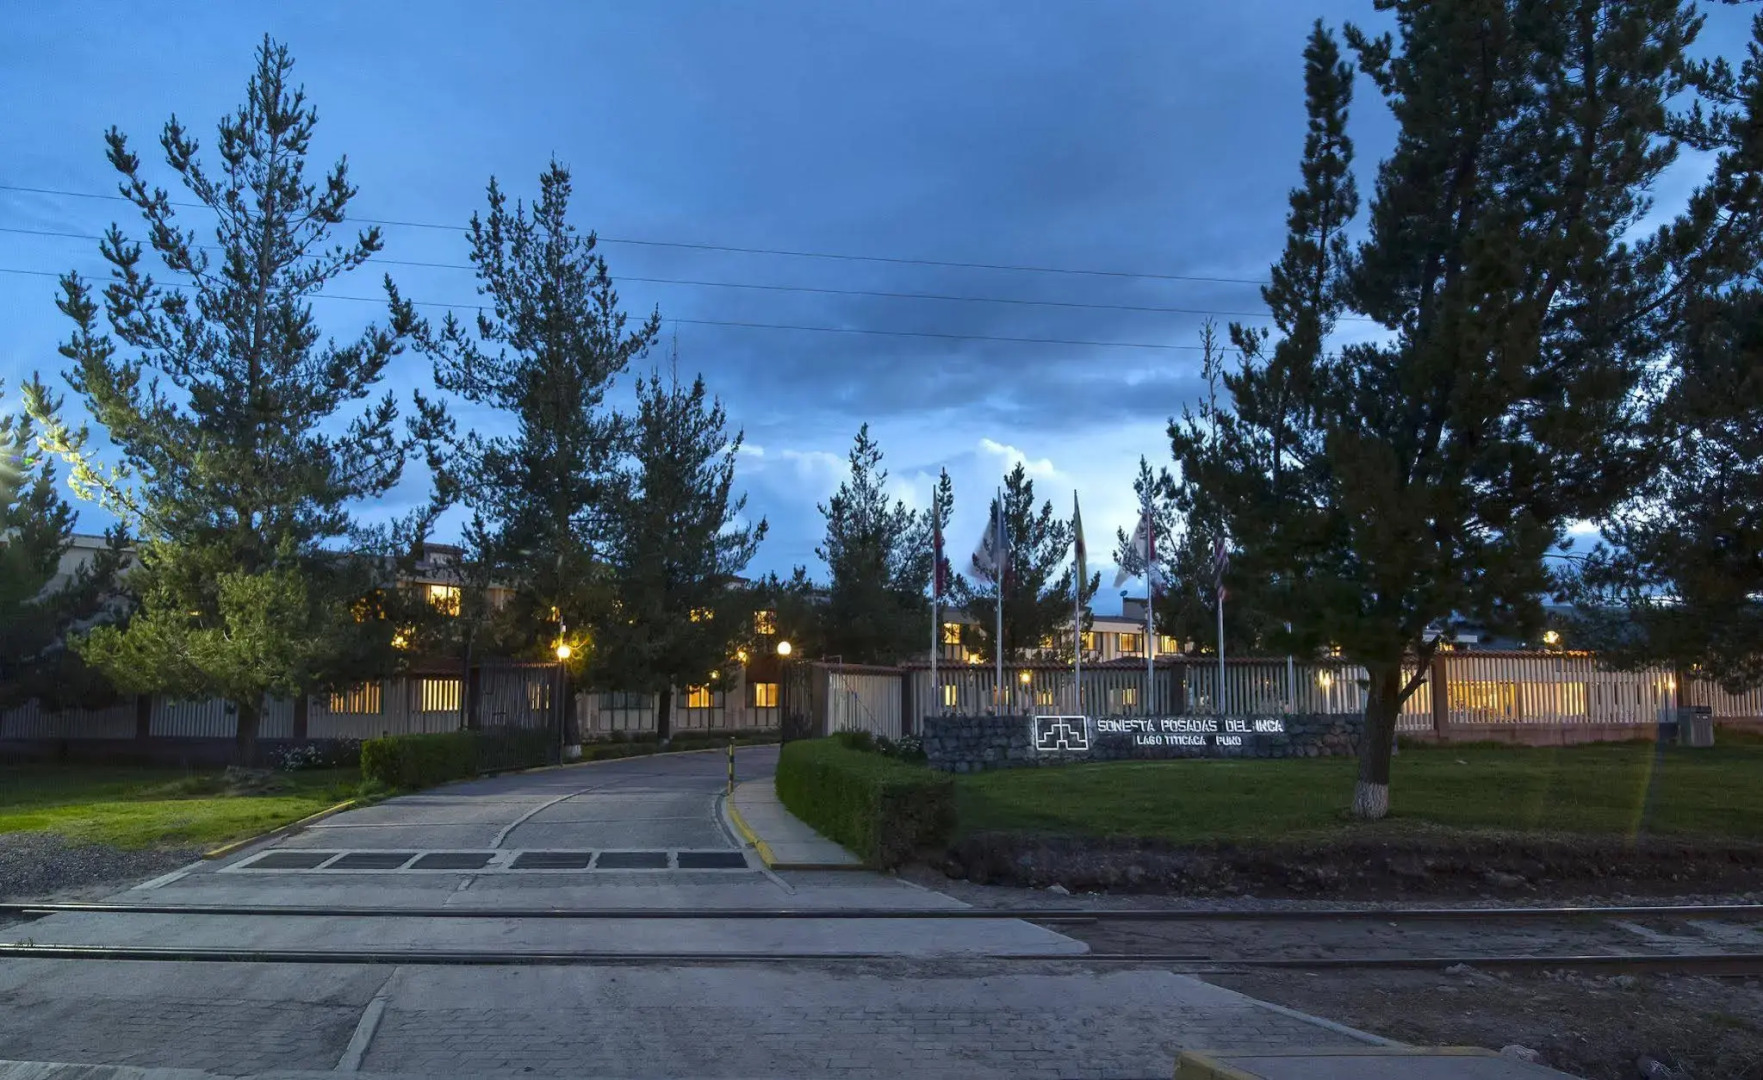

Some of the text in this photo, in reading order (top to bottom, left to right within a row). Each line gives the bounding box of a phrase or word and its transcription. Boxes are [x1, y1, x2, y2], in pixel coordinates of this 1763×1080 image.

[1098, 719, 1284, 732] SONESTA POSADAS DEL INCA
[1136, 735, 1242, 746] LAGO TITICACA PUNO
